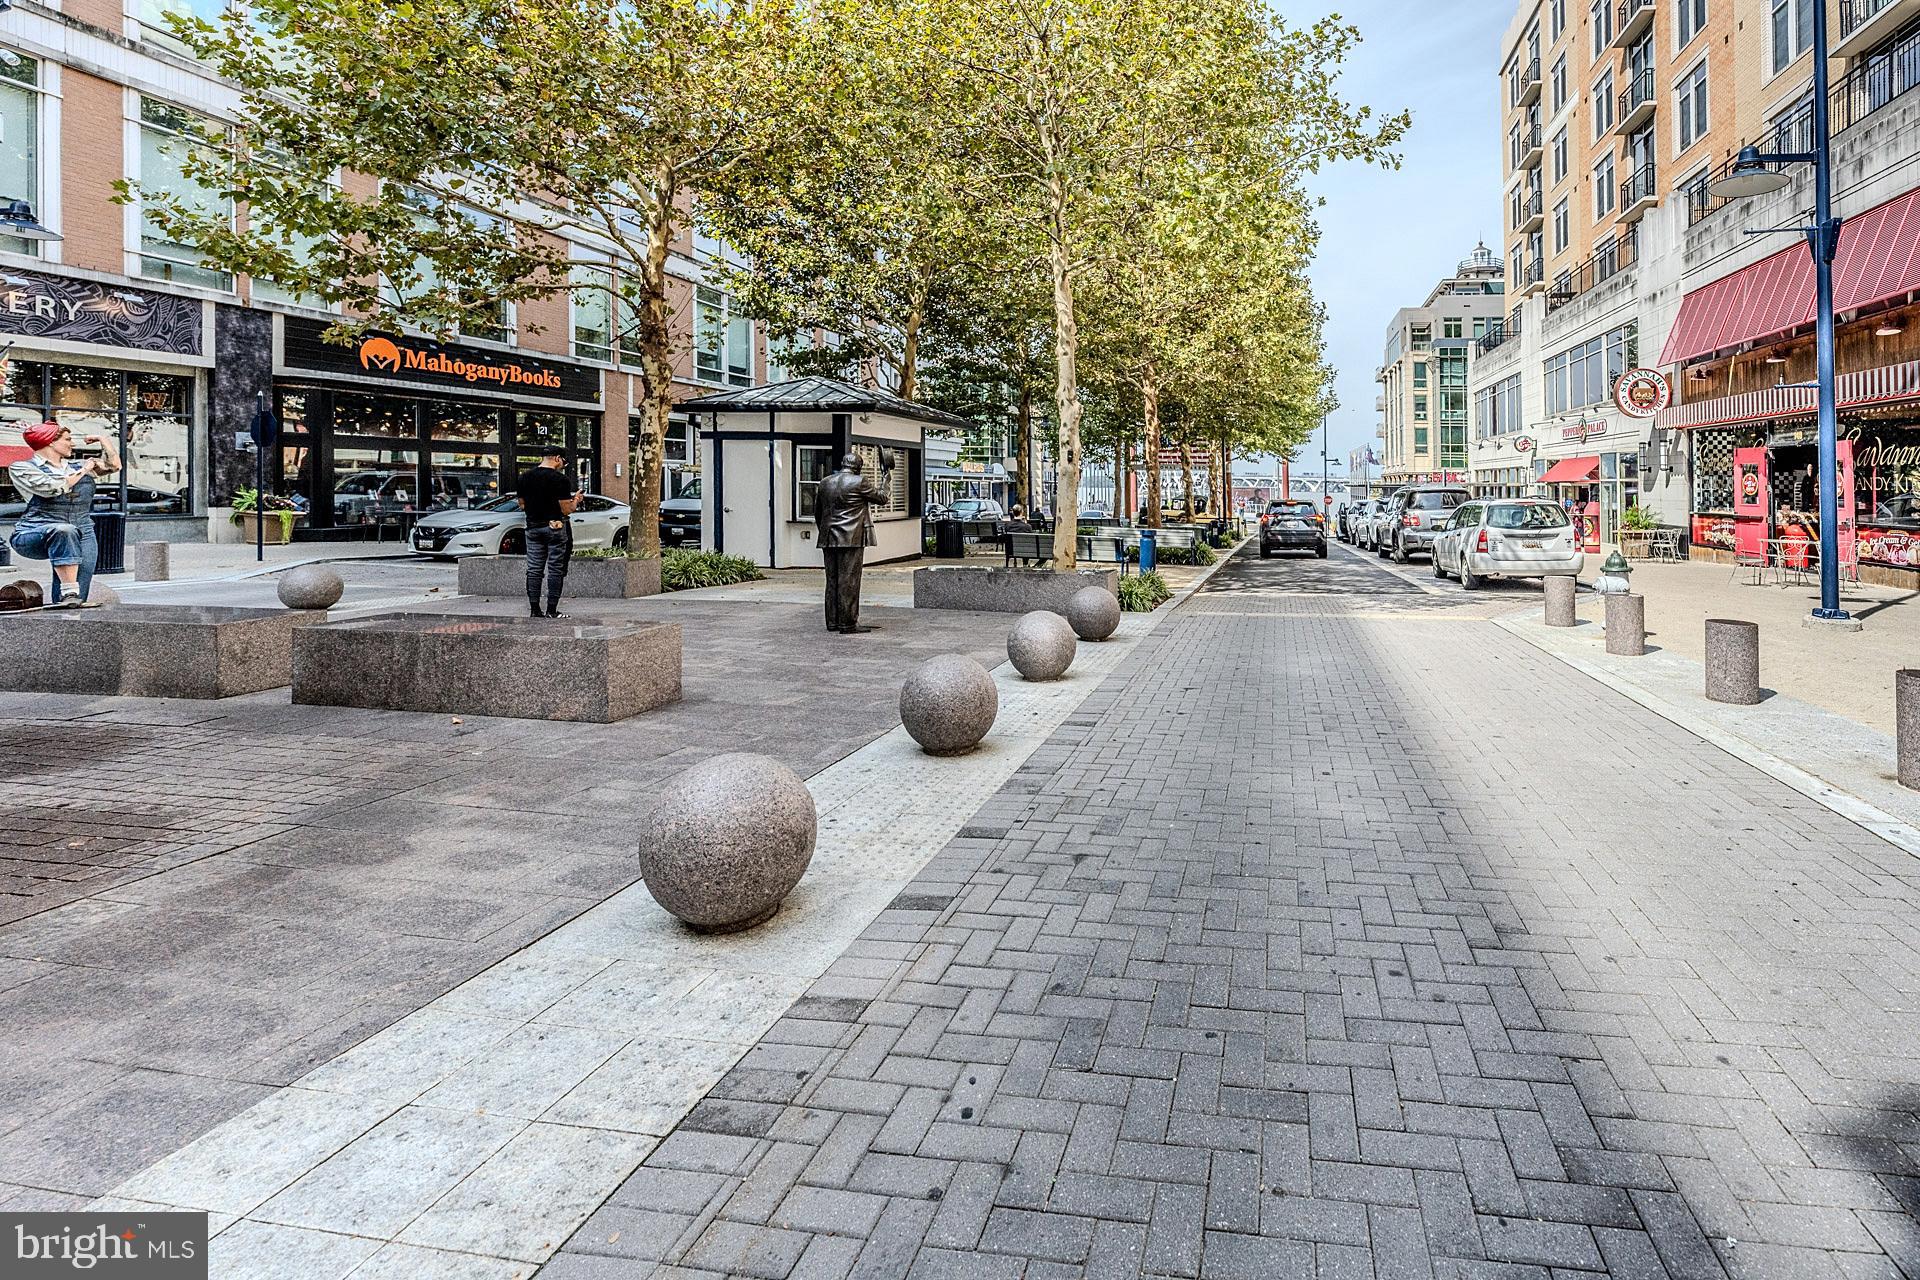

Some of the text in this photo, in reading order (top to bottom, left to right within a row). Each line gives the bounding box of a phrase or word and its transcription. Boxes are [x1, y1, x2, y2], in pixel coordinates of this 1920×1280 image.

[8, 290, 85, 322] ERY
[403, 348, 562, 388] MahoganyBooks
[1621, 371, 1667, 393] SAVANNAH'S
[1621, 395, 1640, 414] CANDY
[537, 426, 548, 435] 121
[1854, 476, 1892, 491] ANDY
[1879, 535, 1900, 545] Cream
